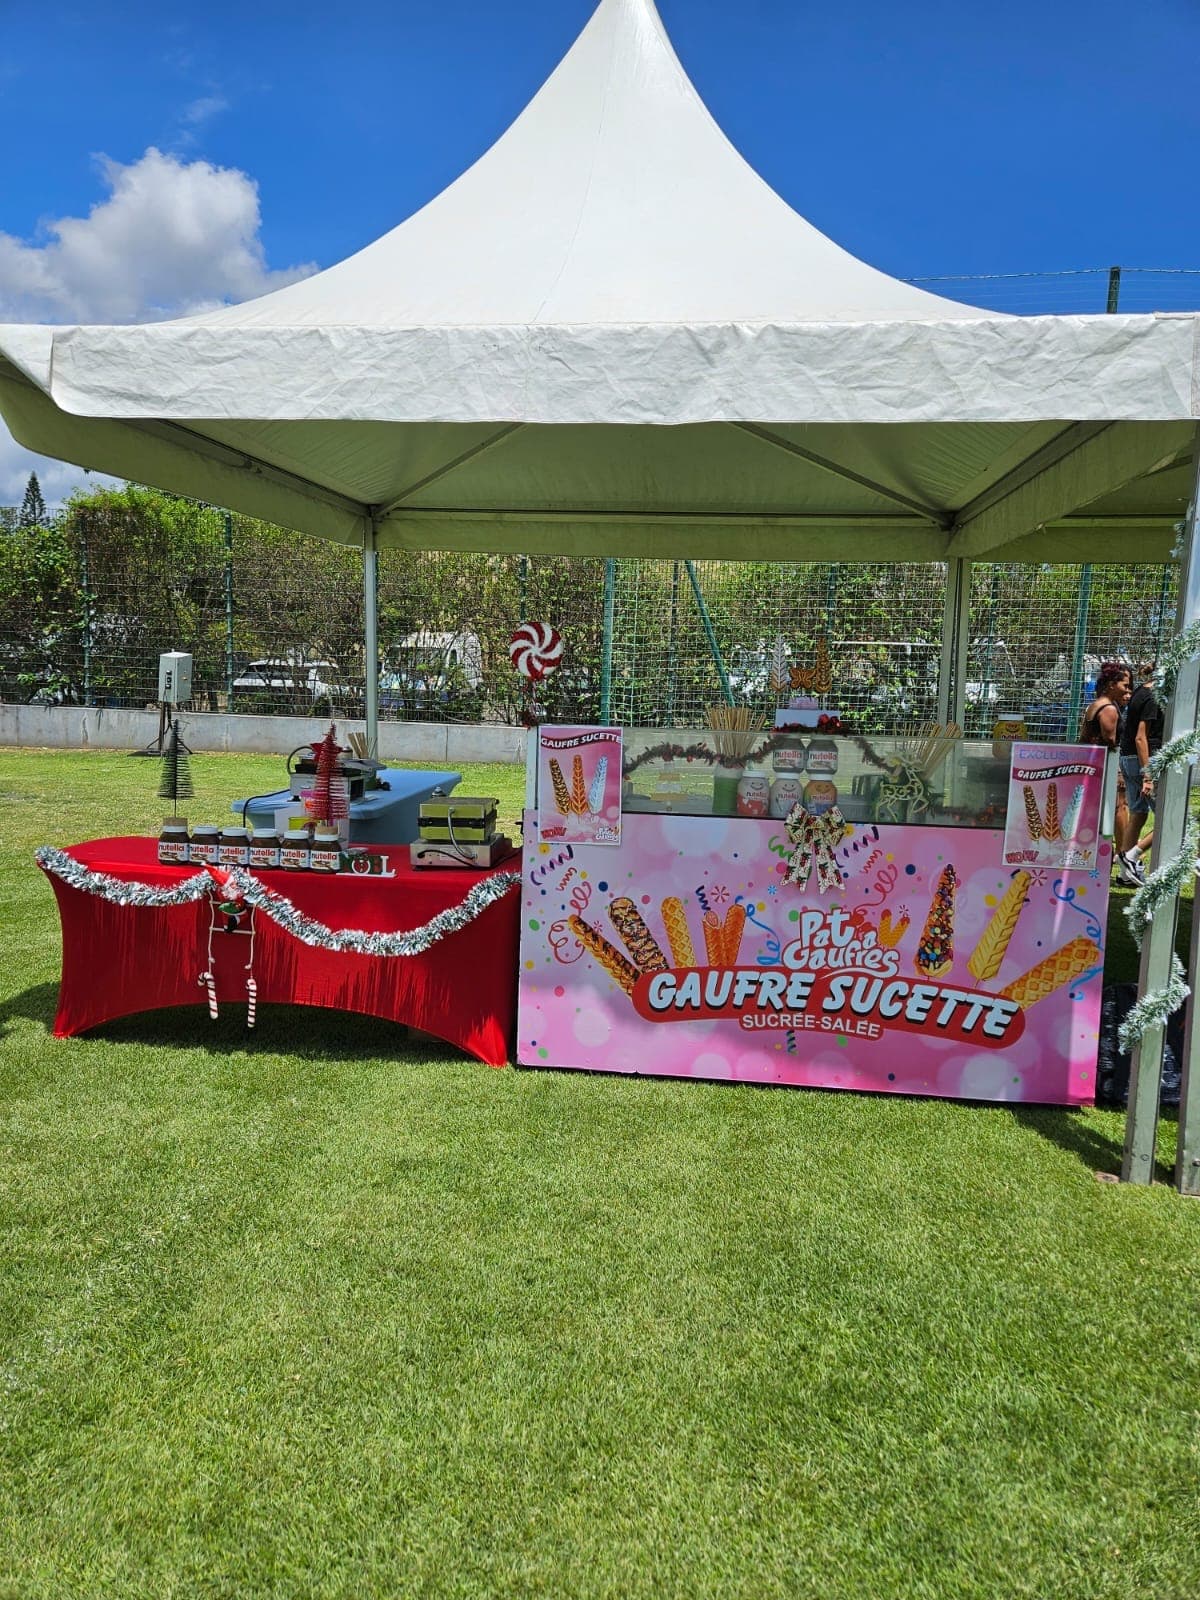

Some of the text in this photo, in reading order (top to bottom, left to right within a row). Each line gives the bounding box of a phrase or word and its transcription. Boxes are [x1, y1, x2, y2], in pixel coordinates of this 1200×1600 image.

[541, 737, 579, 748] GAUFRE
[1017, 764, 1097, 780] GAUFRE SUCETTE
[311, 853, 337, 861] nutella
[800, 908, 855, 948] Pat
[782, 939, 900, 979] Gaufres
[648, 970, 1020, 1039] GAUFRE SUCETTE
[742, 1012, 881, 1038] SUCRÉE-SALÉE
